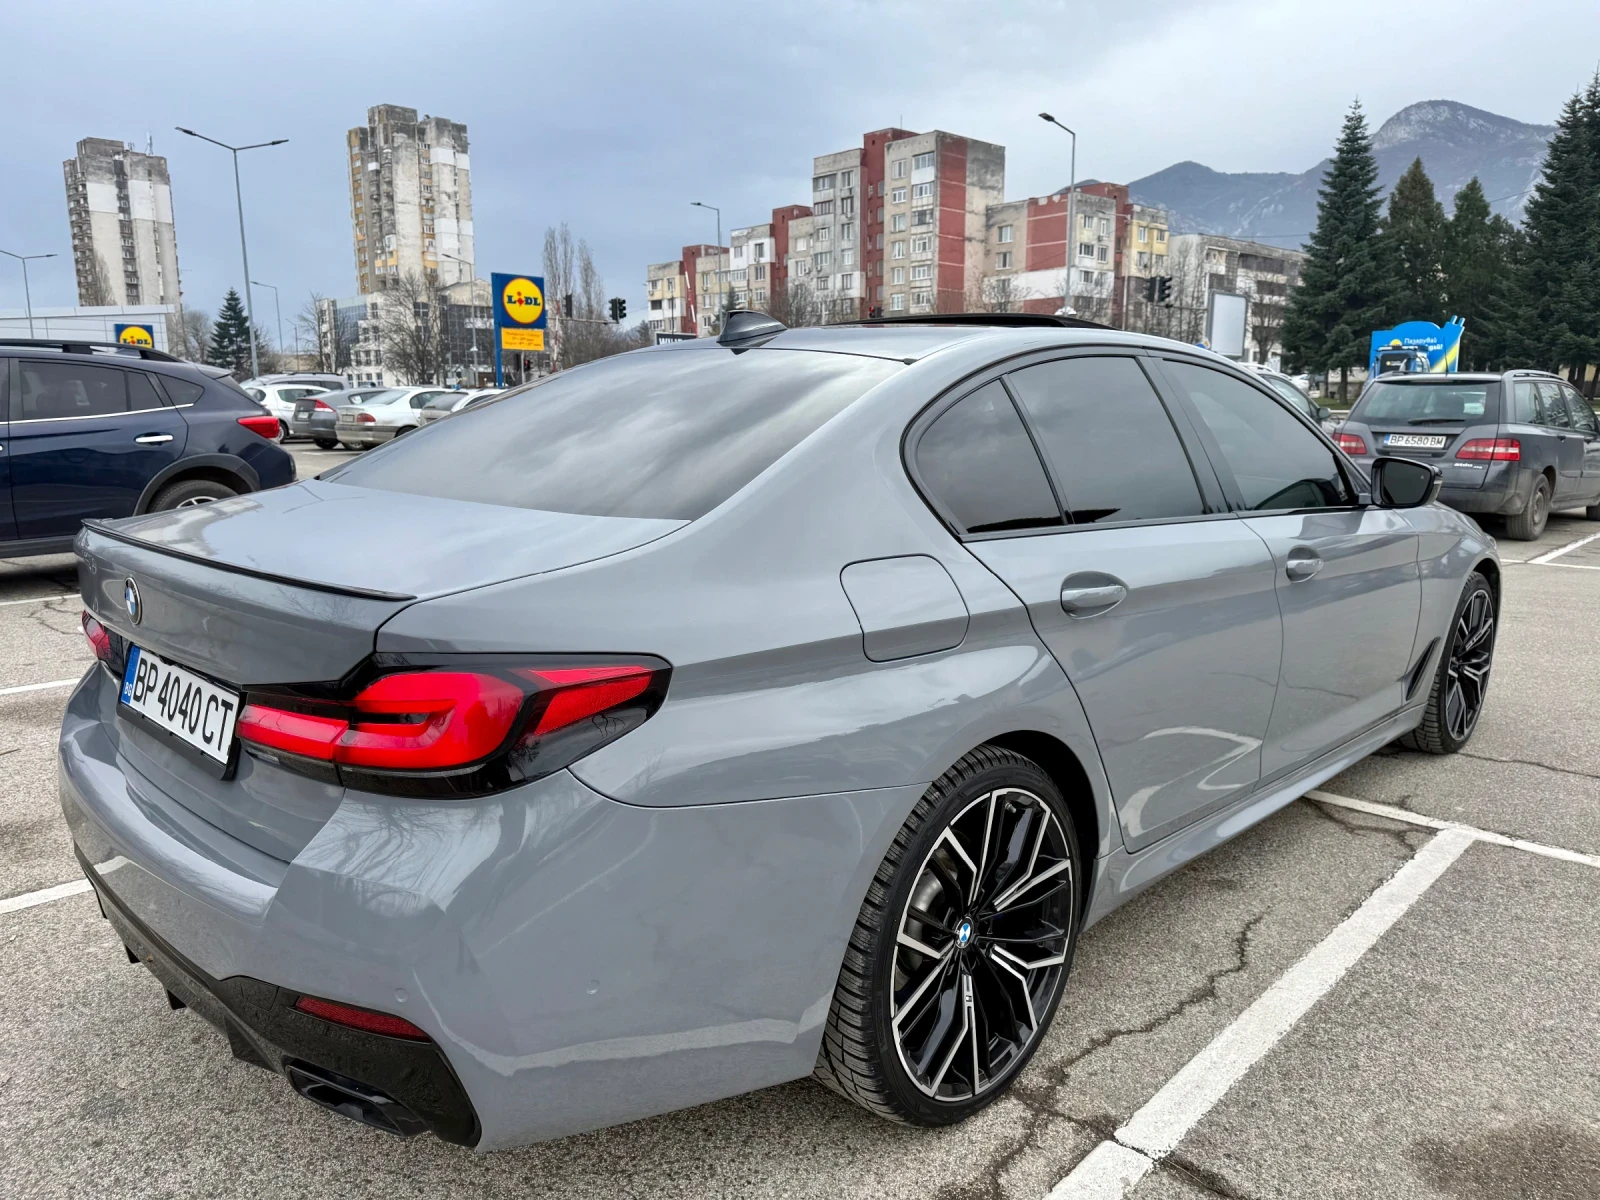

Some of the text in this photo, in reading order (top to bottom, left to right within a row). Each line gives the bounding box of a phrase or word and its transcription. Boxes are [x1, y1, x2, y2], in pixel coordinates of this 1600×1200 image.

[1404, 436, 1429, 446] 6580
[133, 657, 234, 752] BP 4040 CT
